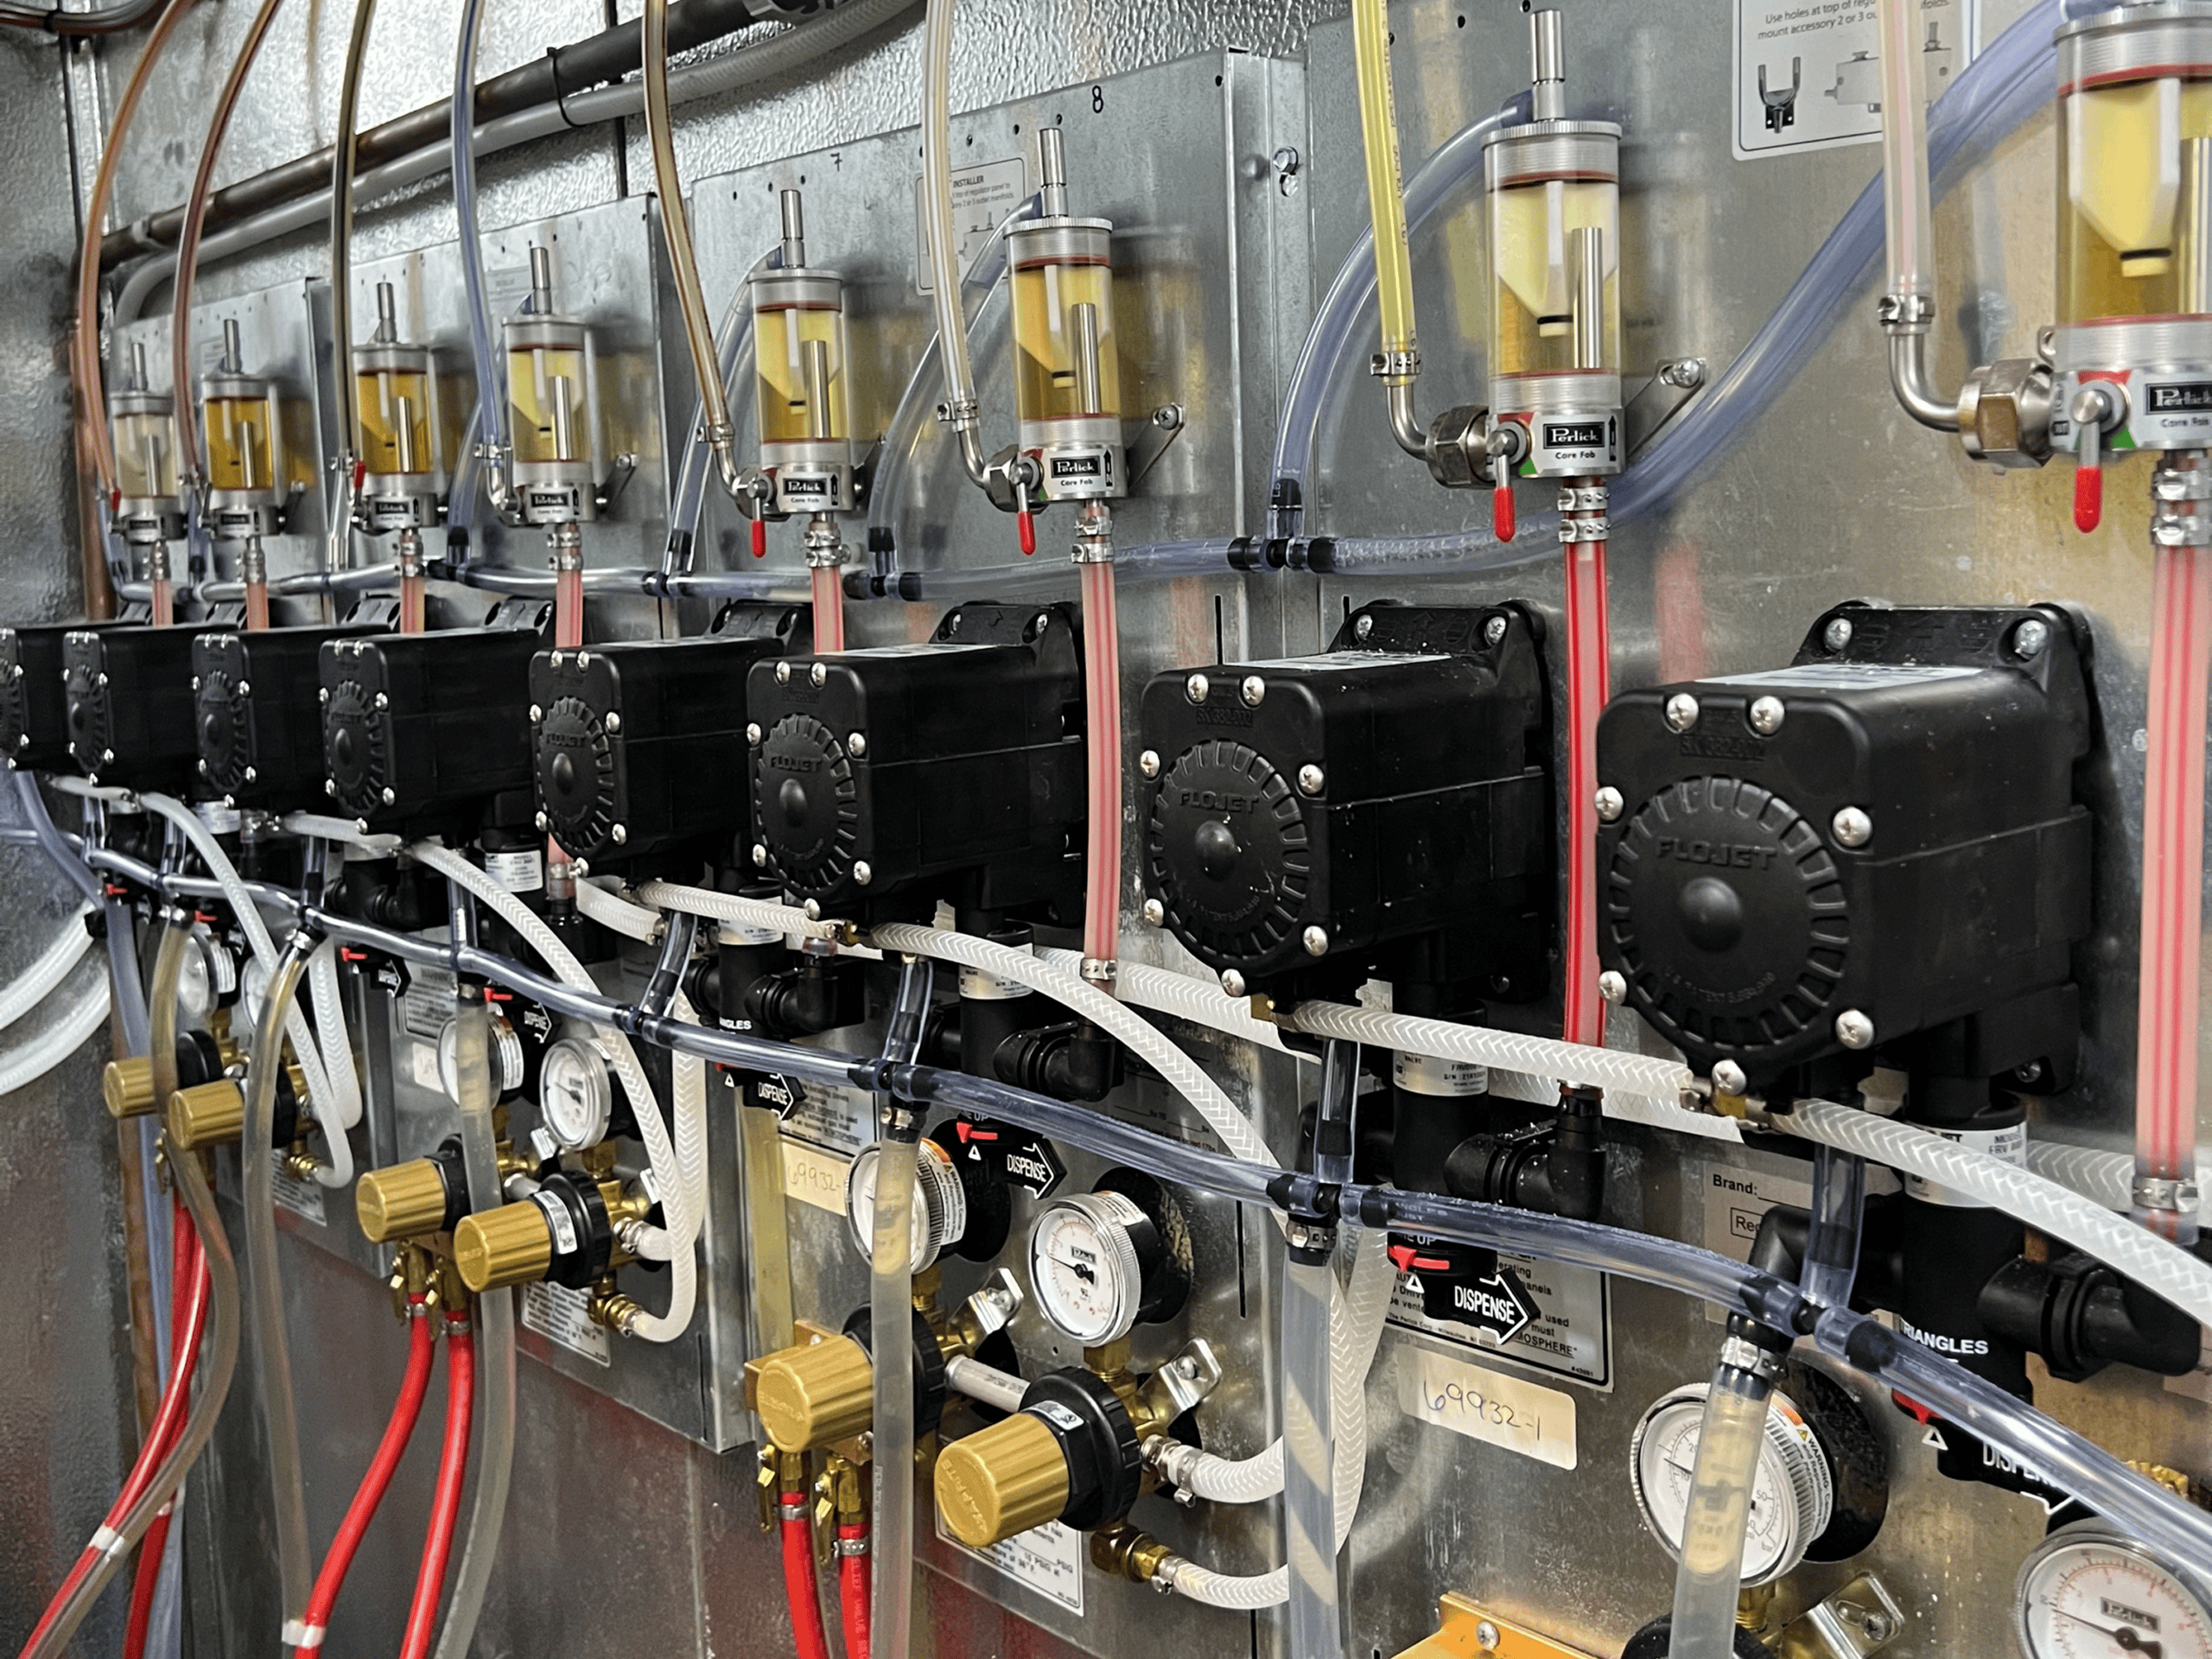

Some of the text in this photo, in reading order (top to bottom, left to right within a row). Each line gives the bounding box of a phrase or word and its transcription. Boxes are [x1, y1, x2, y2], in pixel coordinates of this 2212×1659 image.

[1765, 14, 1783, 24] Use
[1784, 10, 1810, 22] holes
[1822, 3, 1839, 15] top
[1841, 0, 1852, 10] of
[1758, 26, 1789, 40] mount
[1790, 19, 1836, 35] accessory
[1837, 16, 1844, 26] 2
[1846, 15, 1857, 24] or
[1858, 12, 1865, 22] 3
[1091, 86, 1103, 113] 8
[830, 152, 843, 172] 7
[953, 175, 984, 188] INSTALLER
[1550, 428, 1599, 442] Perlick
[1056, 461, 1096, 474] Perlick
[1179, 790, 1260, 814] FLOJET
[1657, 836, 1777, 871] FLOJET
[1007, 1153, 1048, 1183] DISPENSE
[1713, 1173, 1758, 1197] Brand:
[1498, 1262, 1532, 1279] erating
[1454, 1285, 1516, 1325] DISPENSE
[1530, 1323, 1555, 1337] must
[1545, 1314, 1570, 1328] used
[1423, 1380, 1541, 1441] 69932-1
[1756, 1490, 1769, 1502] 50
